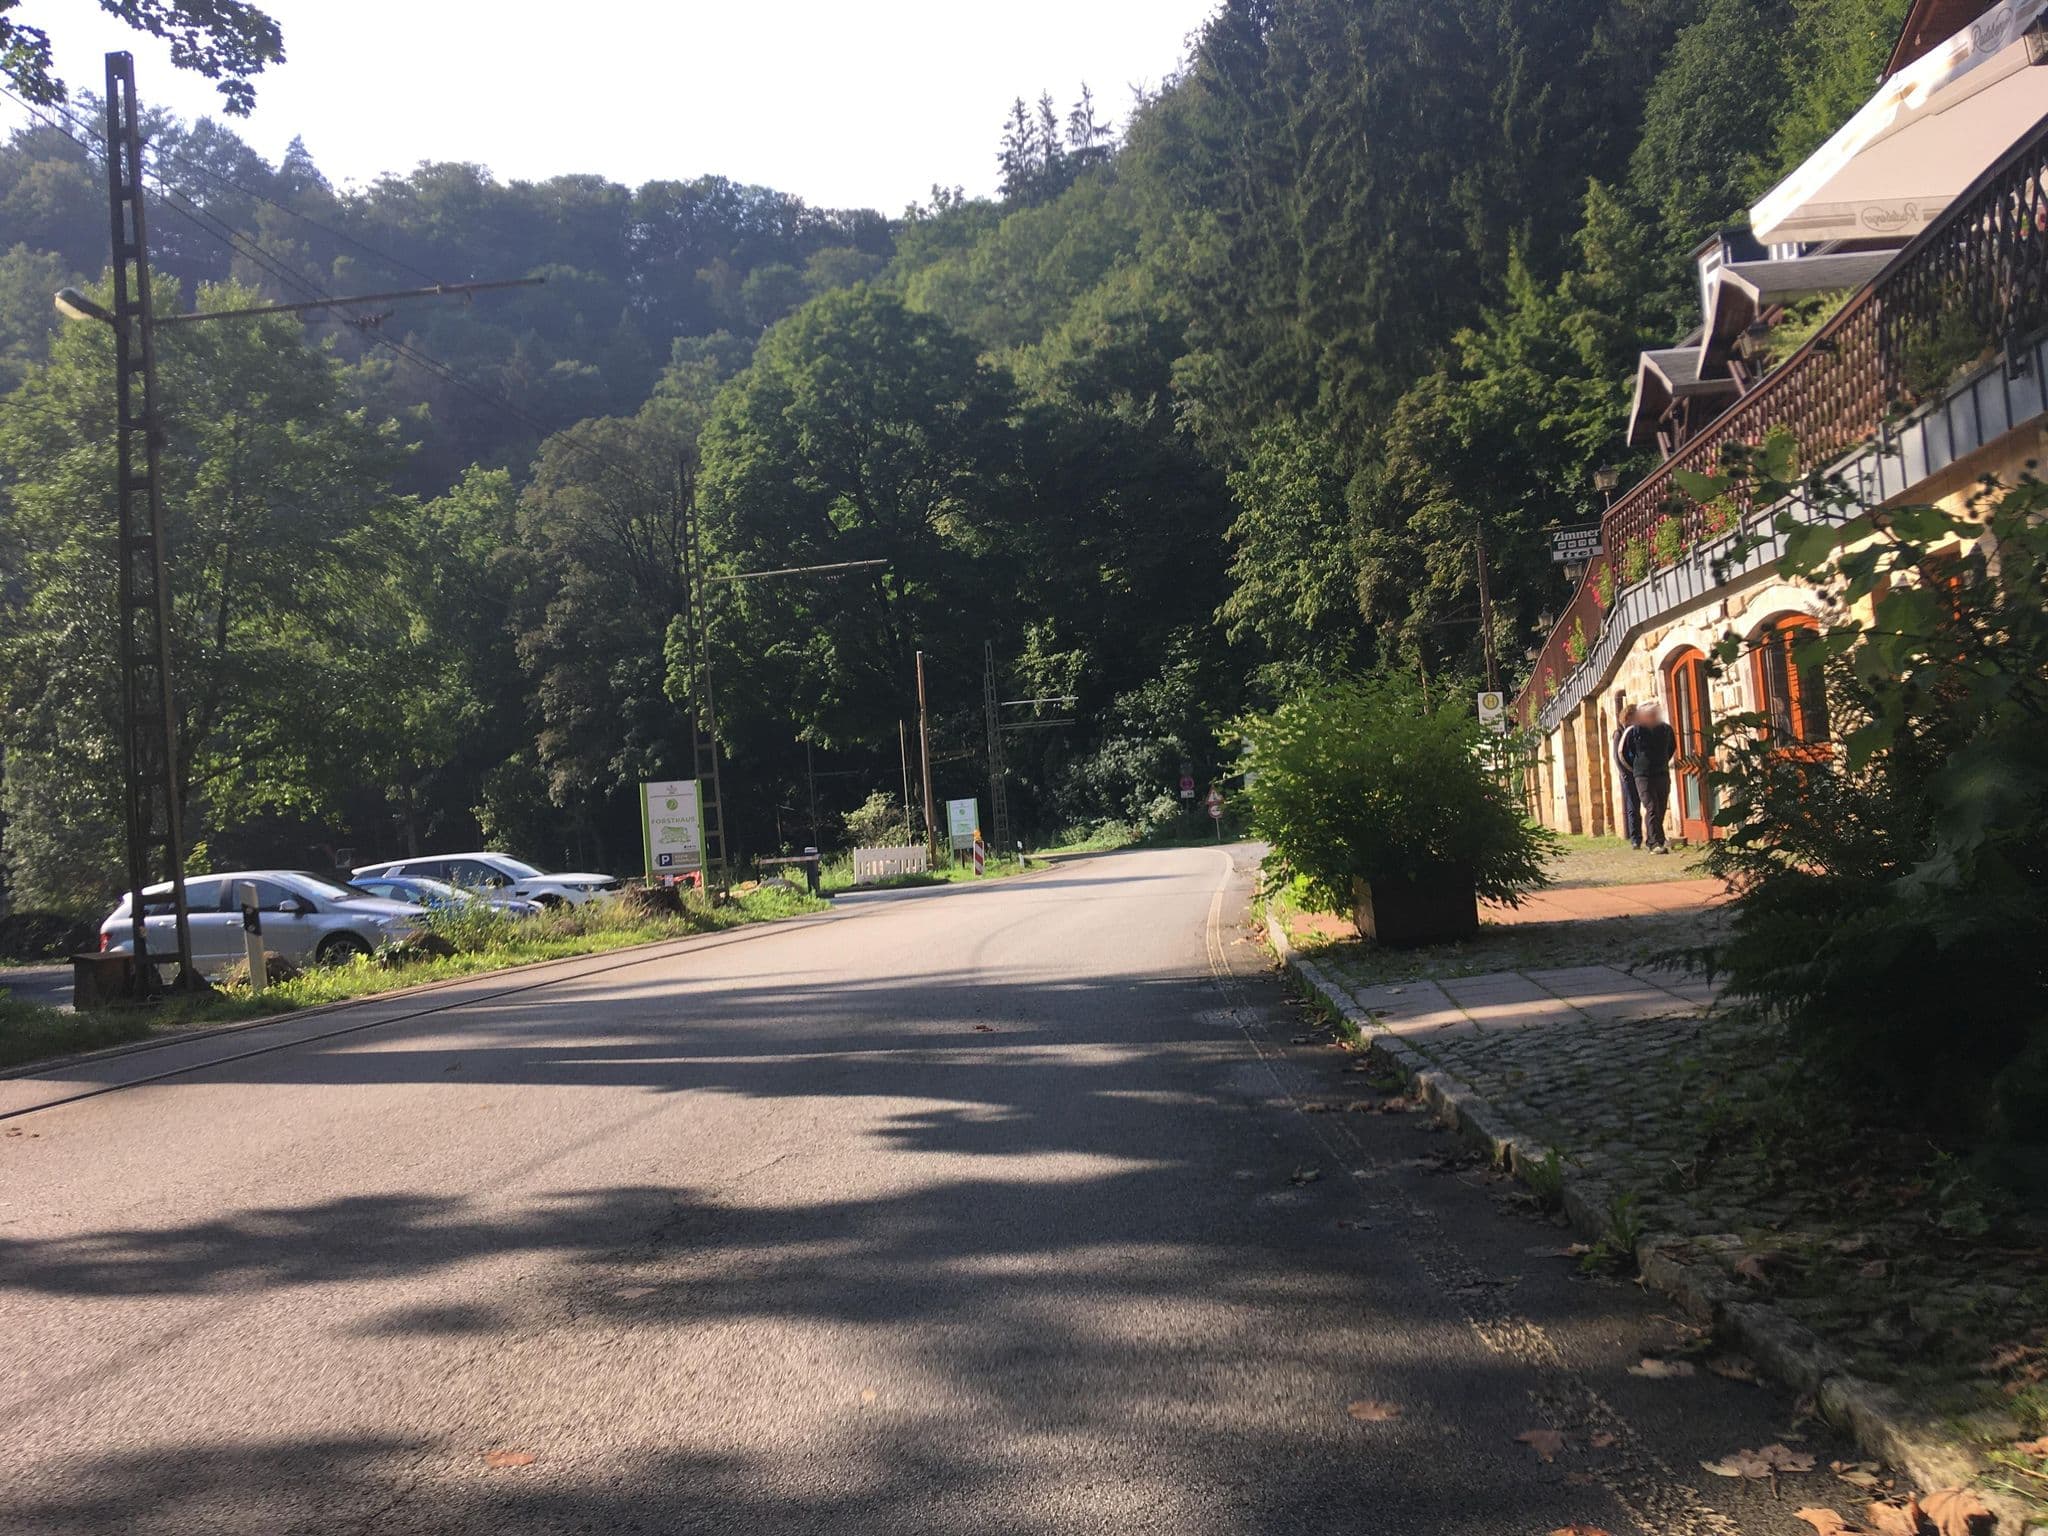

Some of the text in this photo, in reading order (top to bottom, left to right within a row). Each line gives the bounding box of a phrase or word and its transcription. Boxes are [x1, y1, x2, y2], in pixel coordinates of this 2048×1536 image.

[1553, 529, 1600, 542] Zimmer
[1562, 547, 1593, 559] frei
[1487, 697, 1495, 706] H
[651, 815, 696, 825] FORSTHAUS
[661, 855, 670, 865] P
